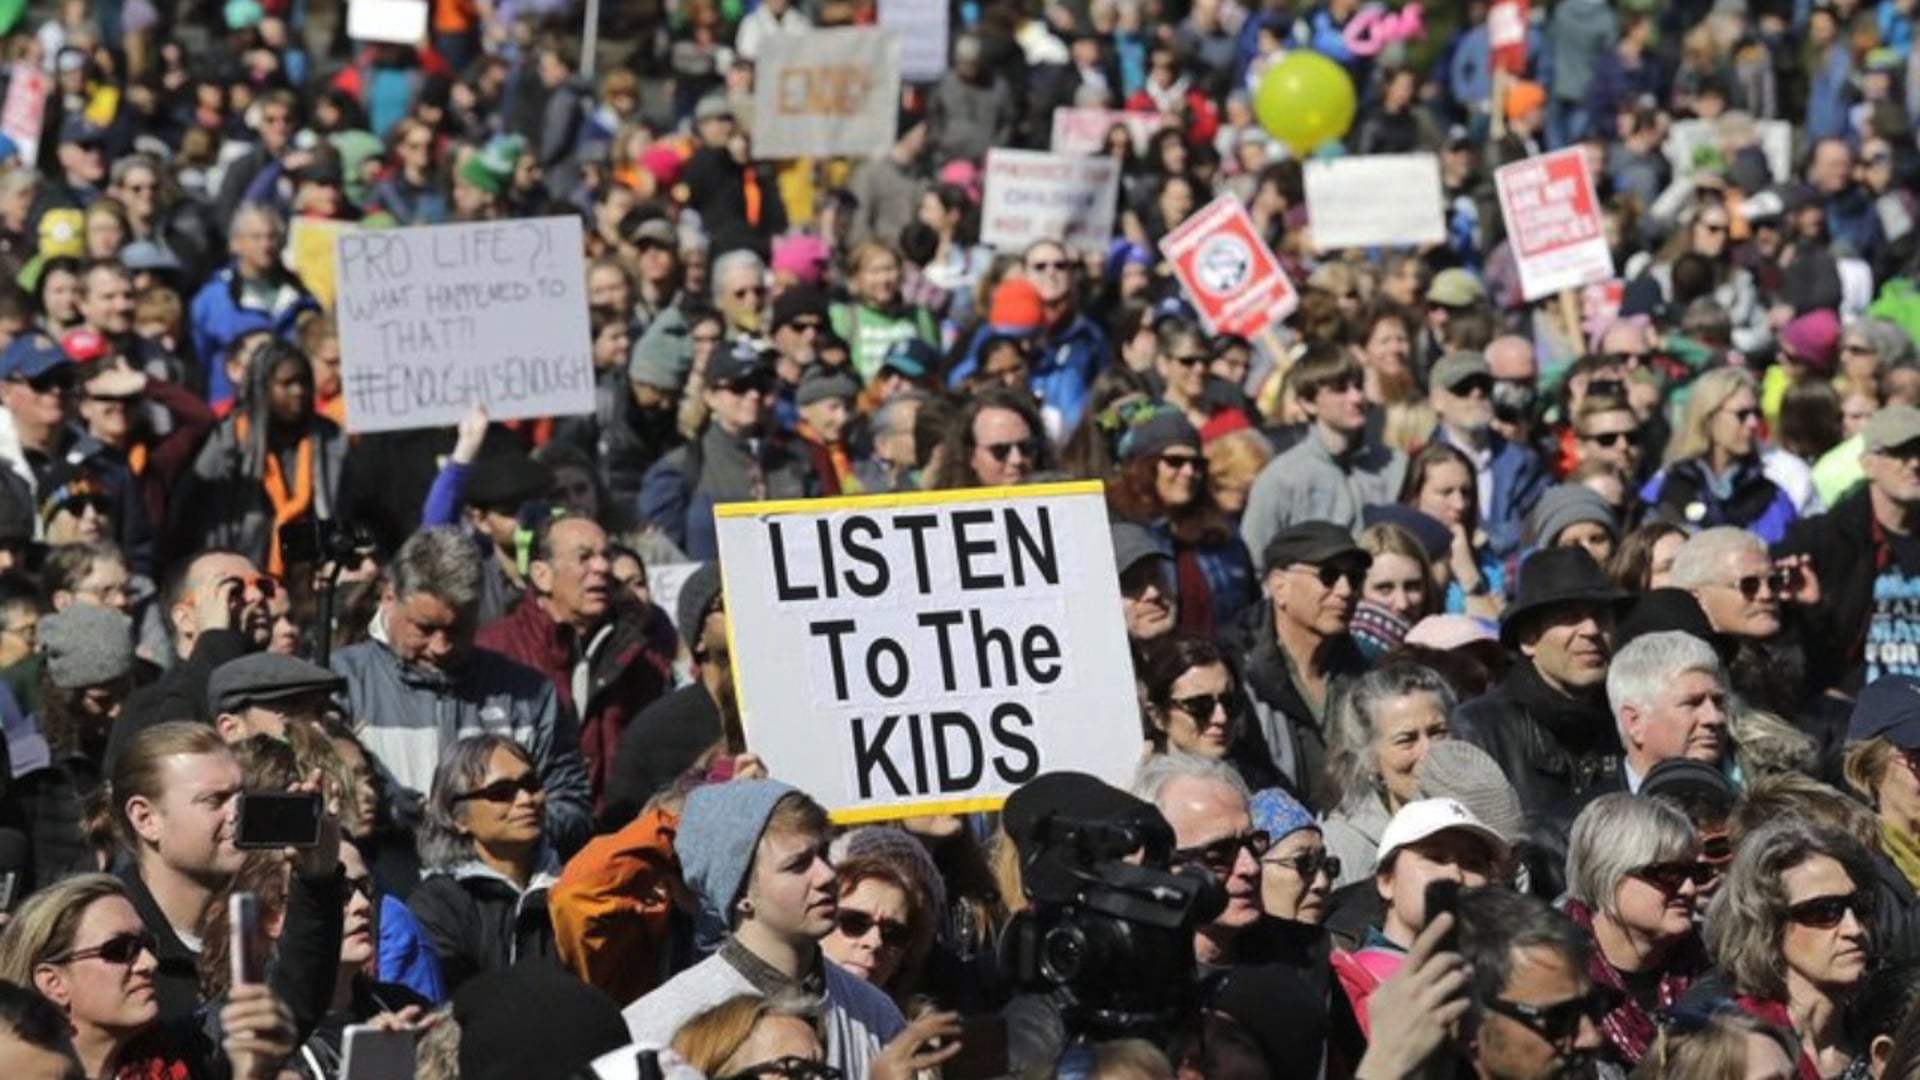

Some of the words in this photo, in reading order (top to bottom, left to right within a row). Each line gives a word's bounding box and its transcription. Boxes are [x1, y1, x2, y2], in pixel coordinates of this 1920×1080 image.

[339, 233, 412, 283] PRO
[345, 285, 414, 321] WHAT
[425, 280, 531, 314] HAPPENED
[537, 278, 567, 299] TO
[768, 506, 1060, 601] LISTEN
[810, 619, 909, 701] To
[917, 609, 1062, 692] The
[851, 702, 1040, 800] KIDS
